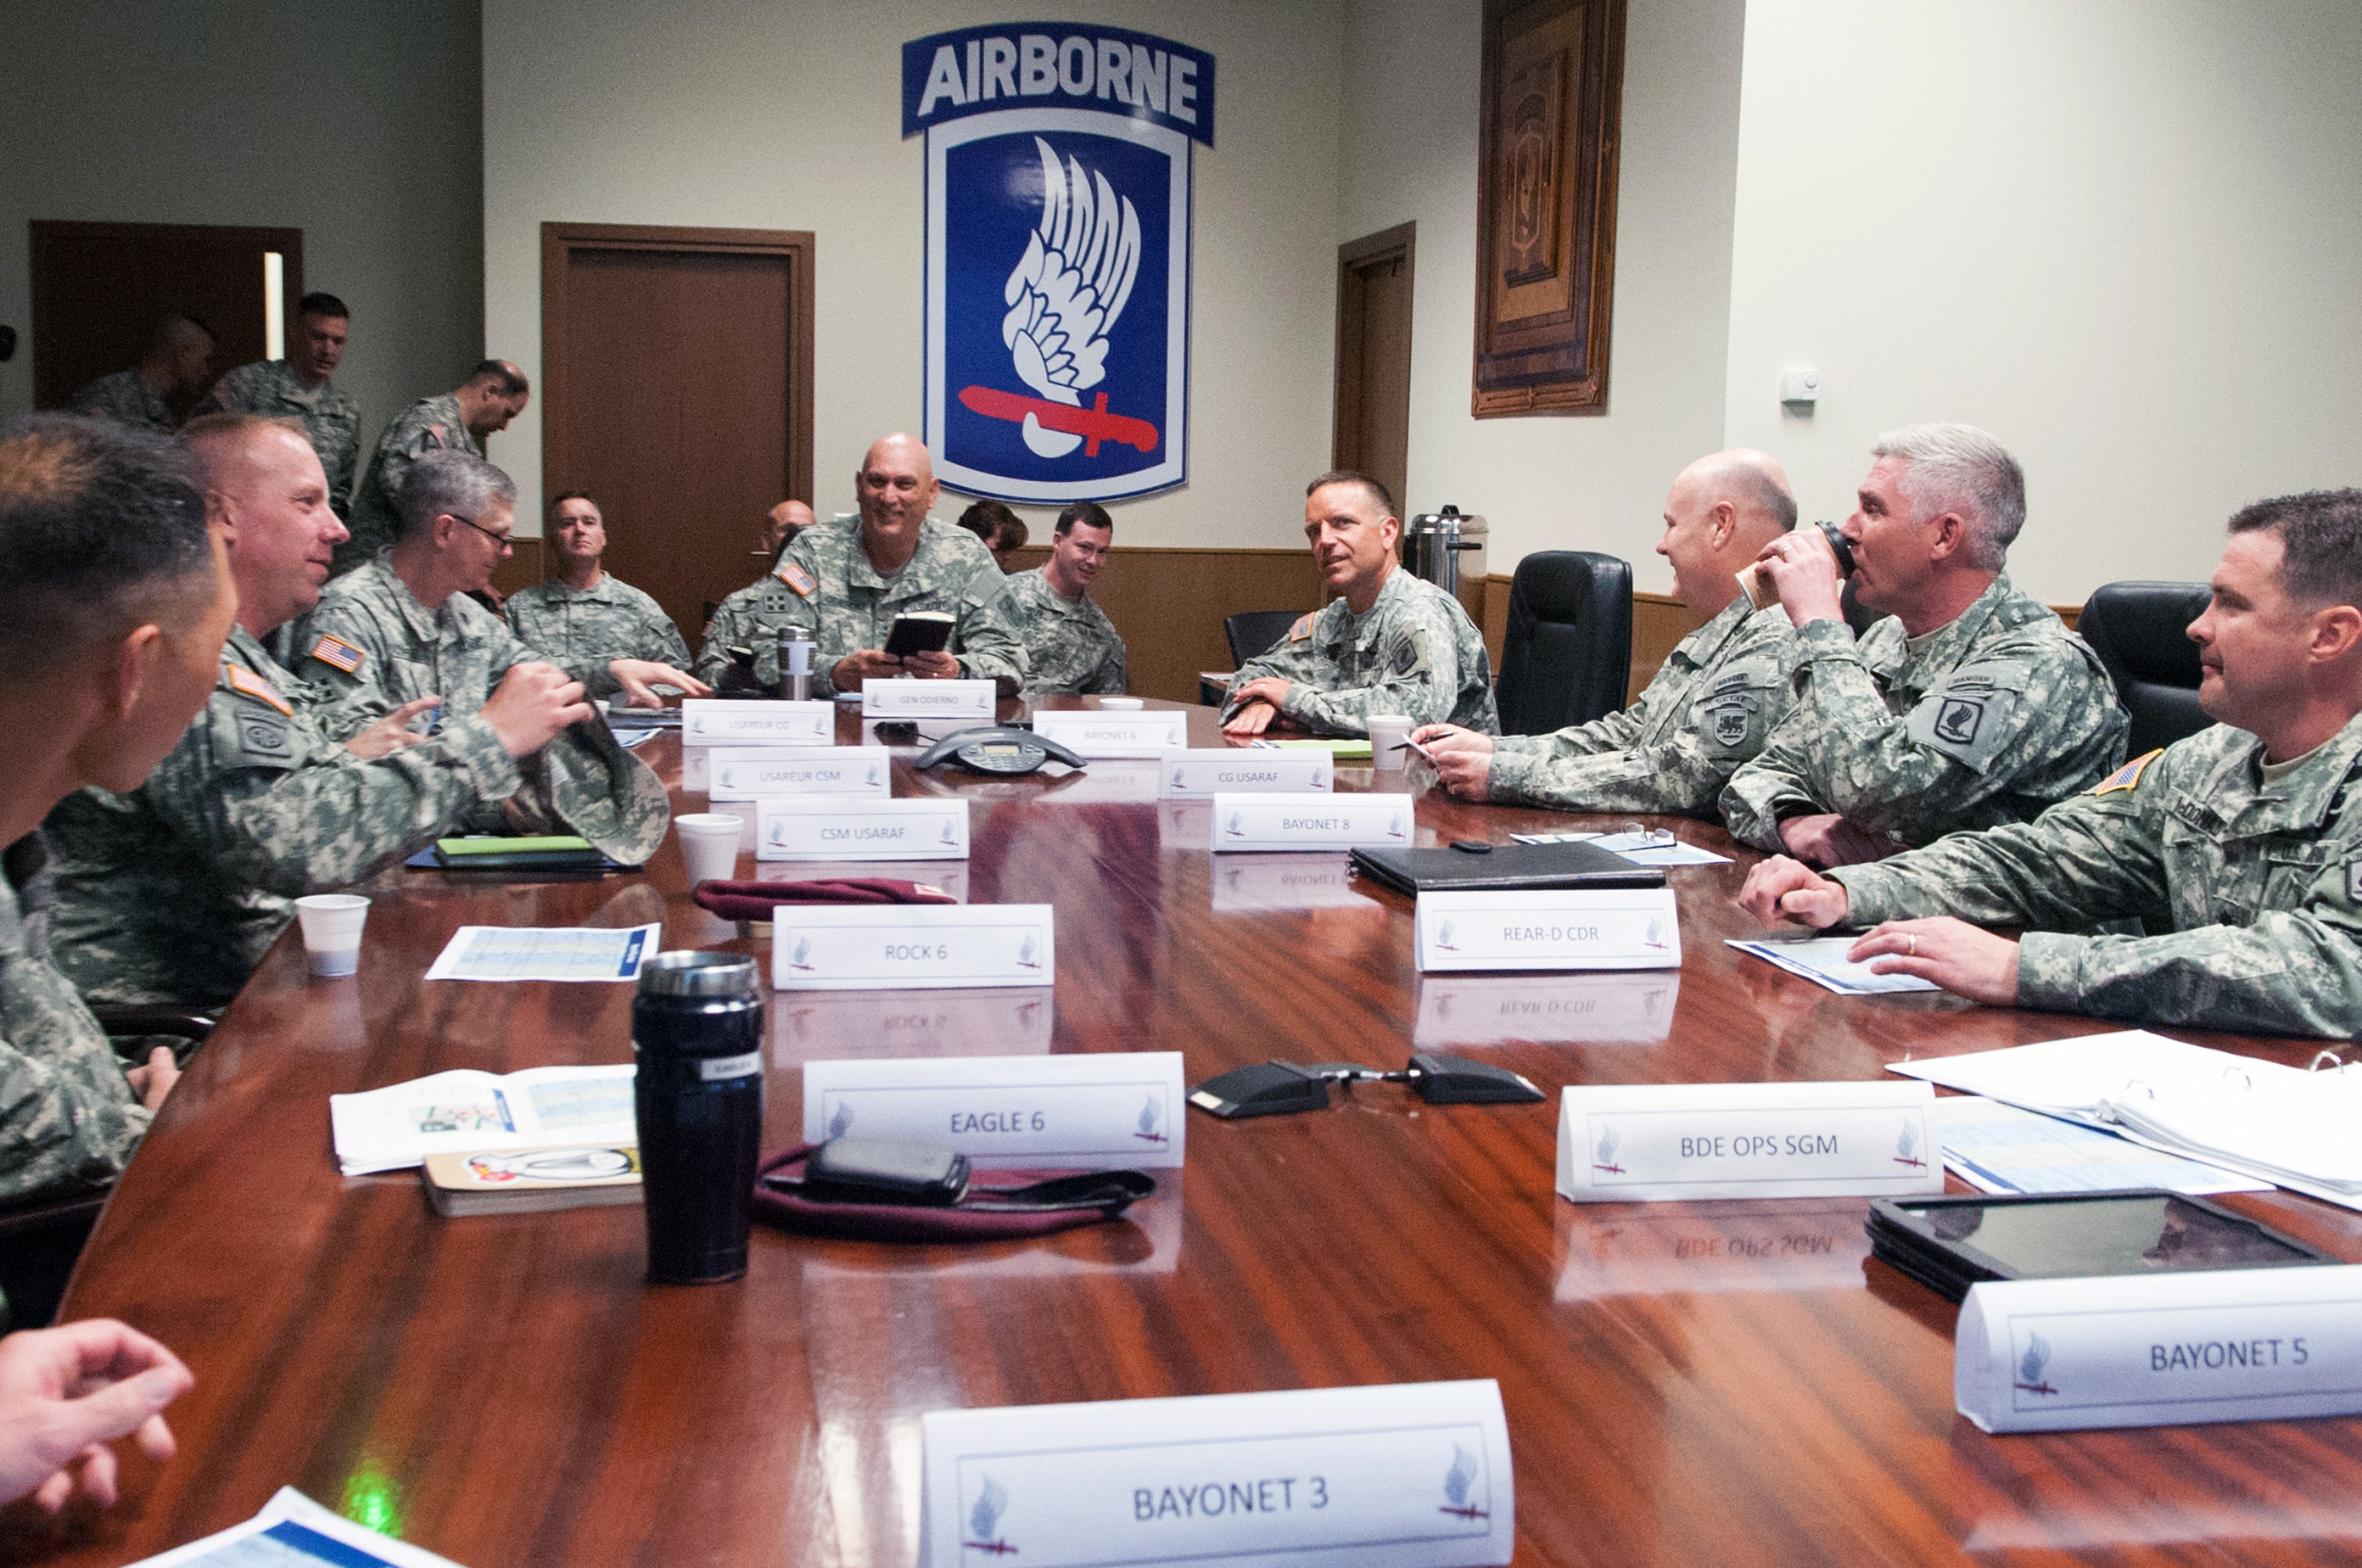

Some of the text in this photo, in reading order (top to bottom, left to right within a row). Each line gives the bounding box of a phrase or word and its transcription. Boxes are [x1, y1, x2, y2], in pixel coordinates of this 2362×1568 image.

[917, 34, 1197, 125] AIRBORNE
[900, 696, 959, 704] GEN ODIERNO
[730, 720, 789, 730] USAREUR CG
[1084, 731, 1137, 741] BAYONET 6
[760, 771, 841, 782] USAREUR CSM
[1218, 772, 1278, 783] CG USARAF
[1283, 819, 1351, 831] BAYONET 8
[821, 827, 905, 840] CSM USARAF
[1503, 927, 1599, 941] REAR-D CDR
[885, 945, 948, 960] ROCK 6
[950, 1112, 1045, 1134] EAGLE 6
[1681, 1134, 1838, 1158] BDE OPS SGM
[2151, 1338, 2309, 1371] BAYONET 5
[1133, 1477, 1329, 1521] BAYONET 3
